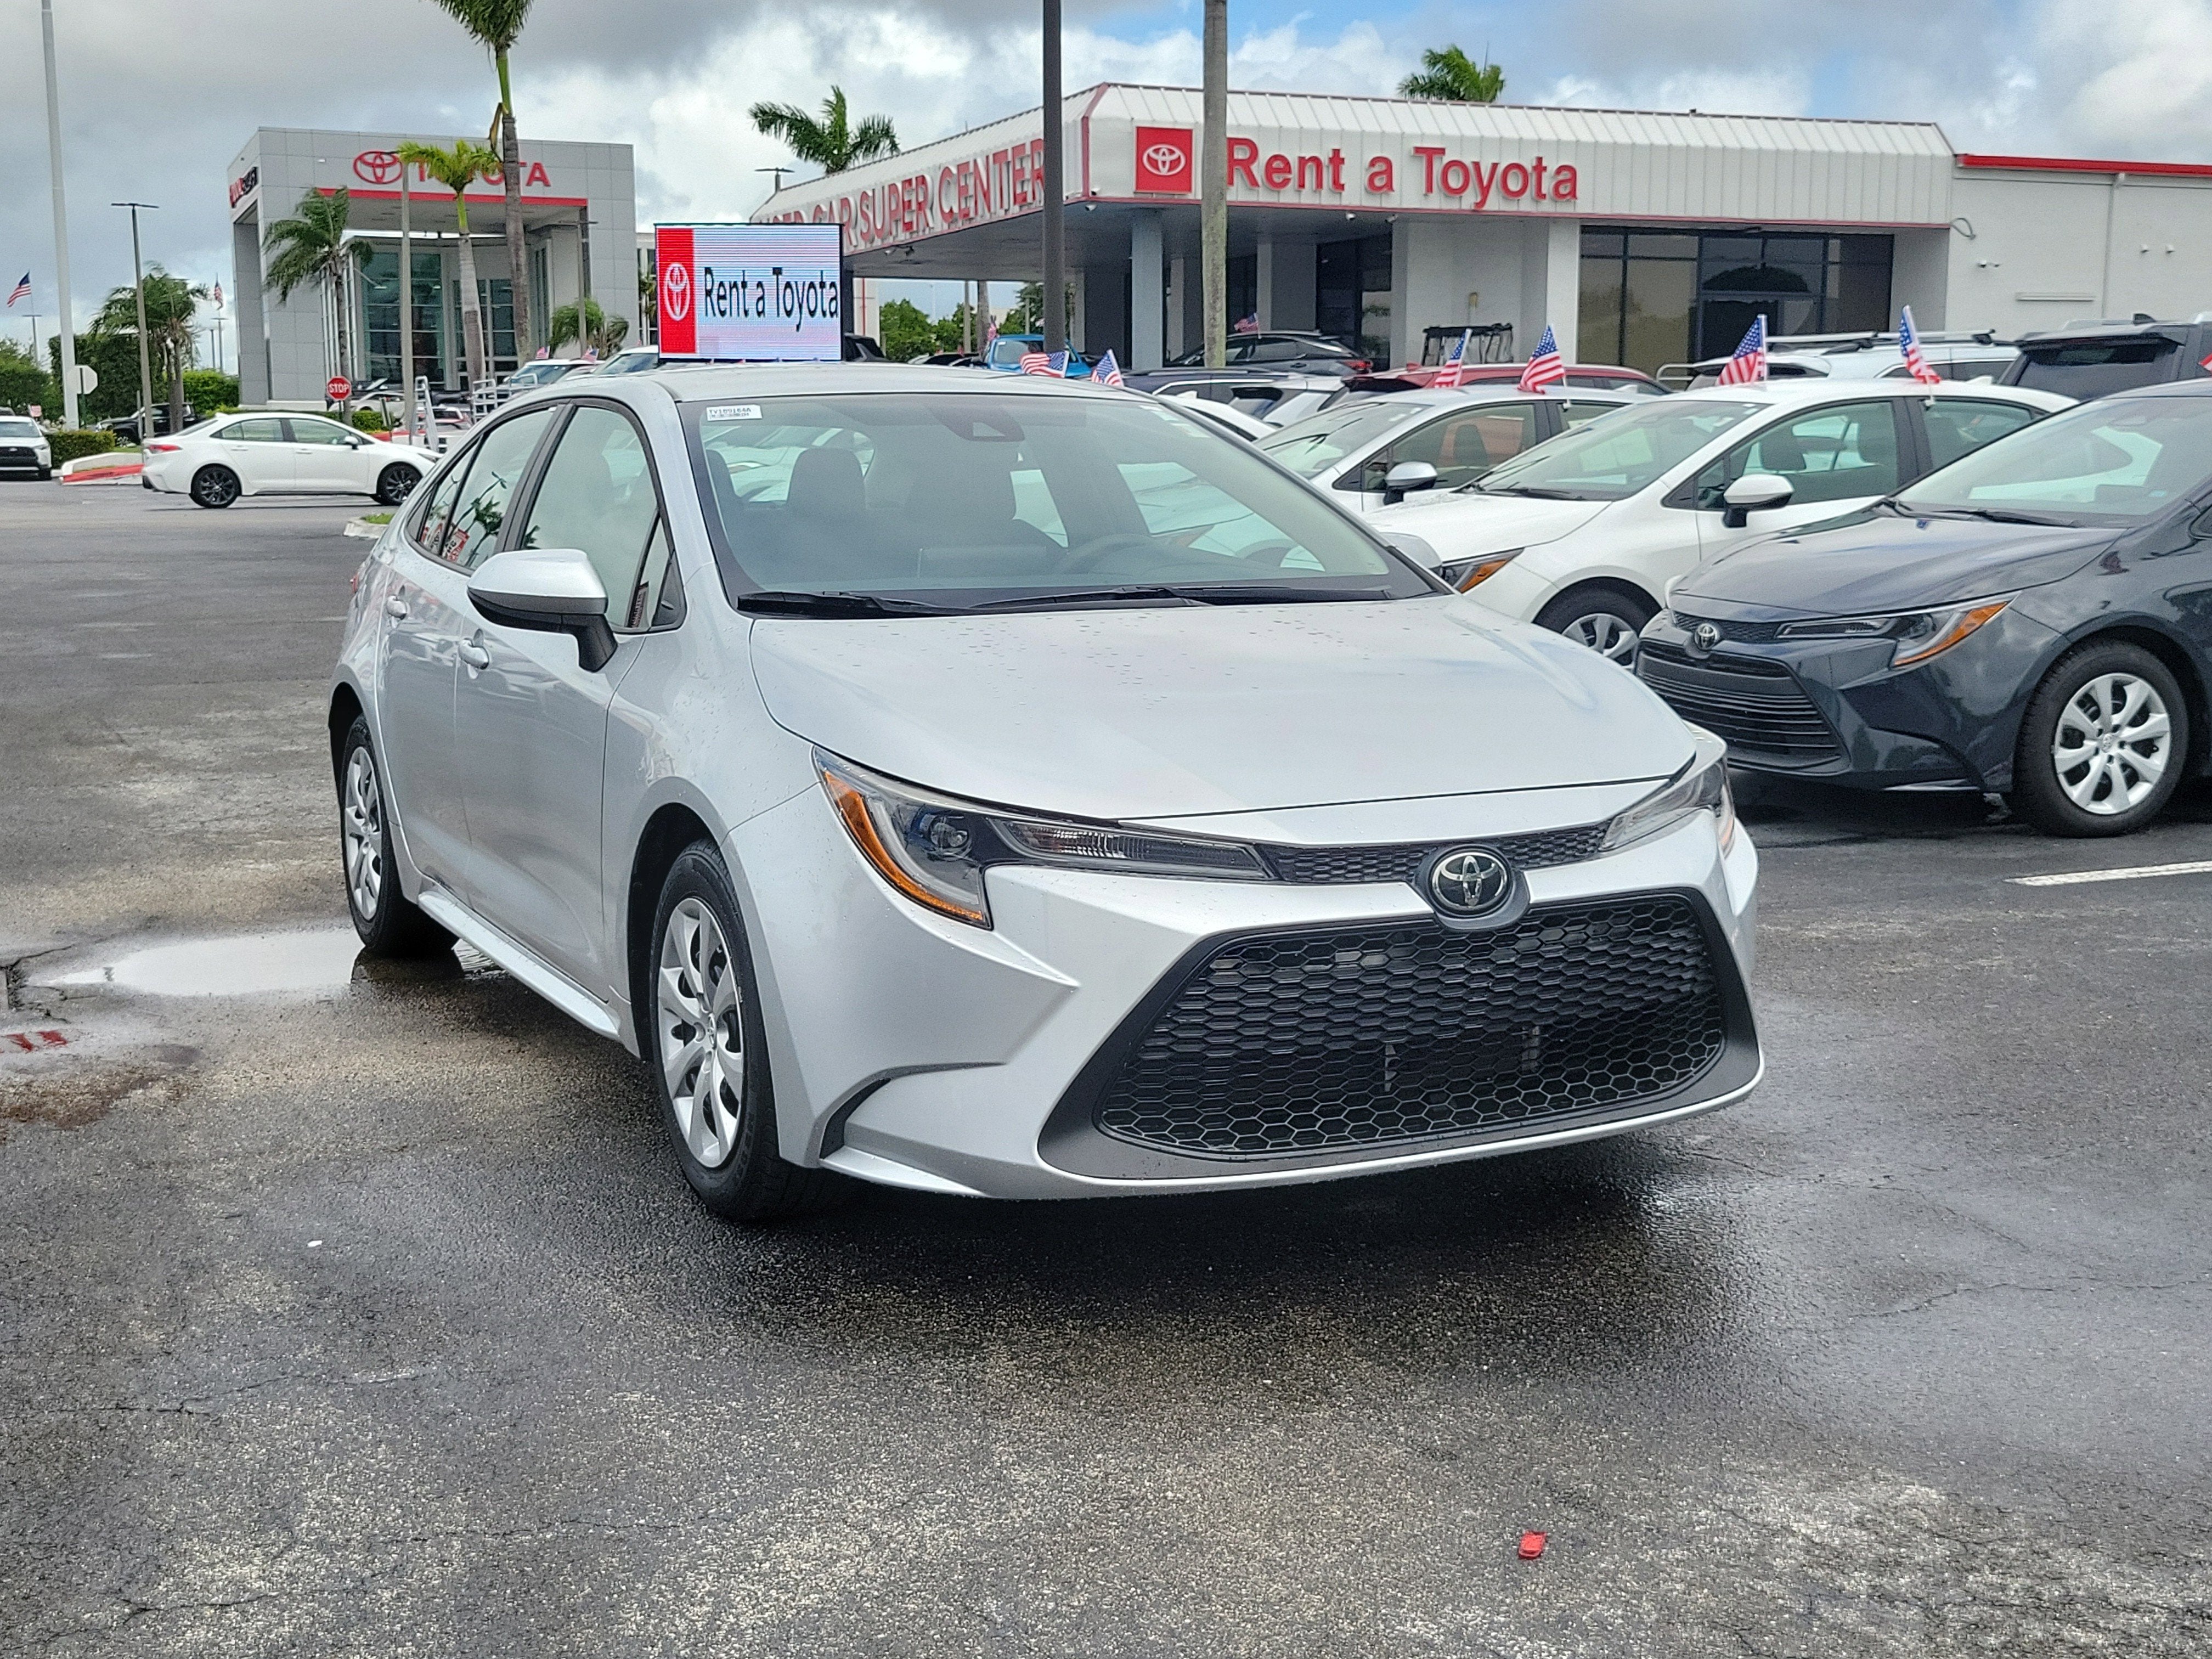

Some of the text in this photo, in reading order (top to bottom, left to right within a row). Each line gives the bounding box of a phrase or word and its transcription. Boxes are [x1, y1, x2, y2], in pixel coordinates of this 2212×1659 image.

[859, 174, 933, 243] SUPER
[939, 138, 1043, 224] CENTER
[1227, 137, 1578, 210] Rent a Toyota
[704, 267, 838, 332] Rent a Toyota
[329, 383, 349, 393] STOP
